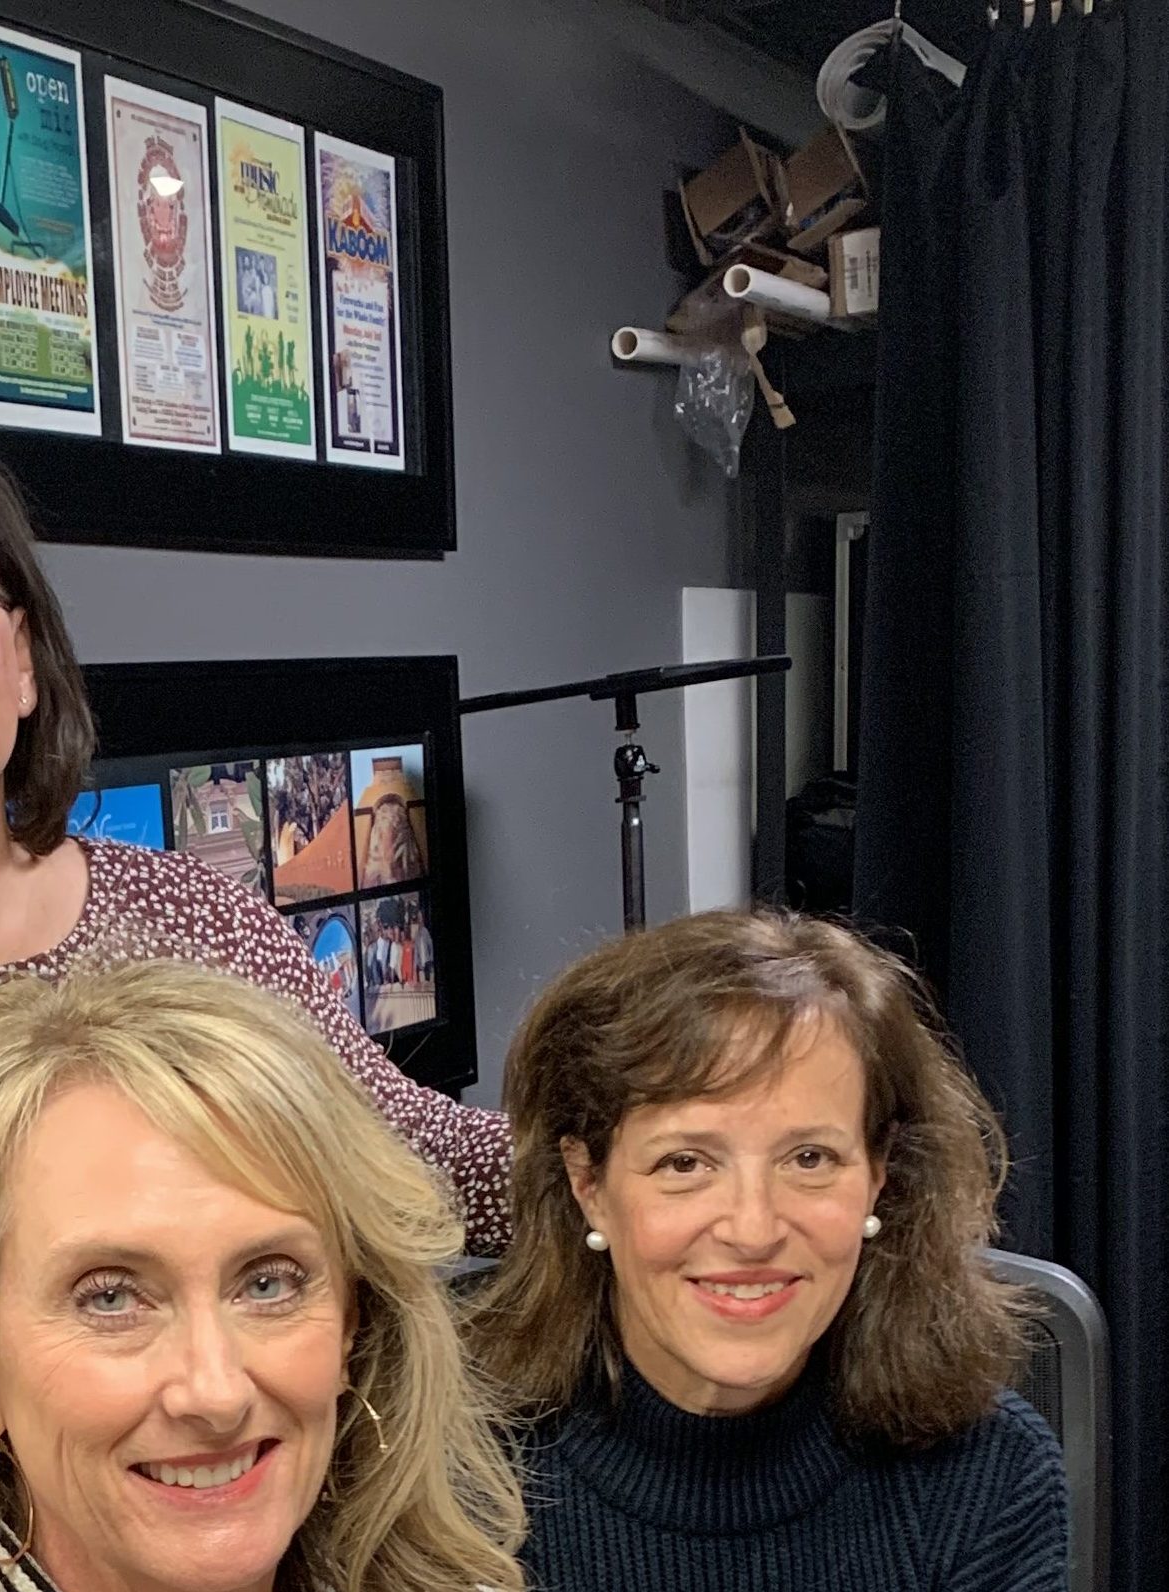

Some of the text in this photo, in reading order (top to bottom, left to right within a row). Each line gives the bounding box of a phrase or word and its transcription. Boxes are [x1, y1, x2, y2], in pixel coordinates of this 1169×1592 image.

[26, 71, 70, 104] open
[327, 217, 390, 266] KABOOM
[40, 274, 88, 319] MEETINGS
